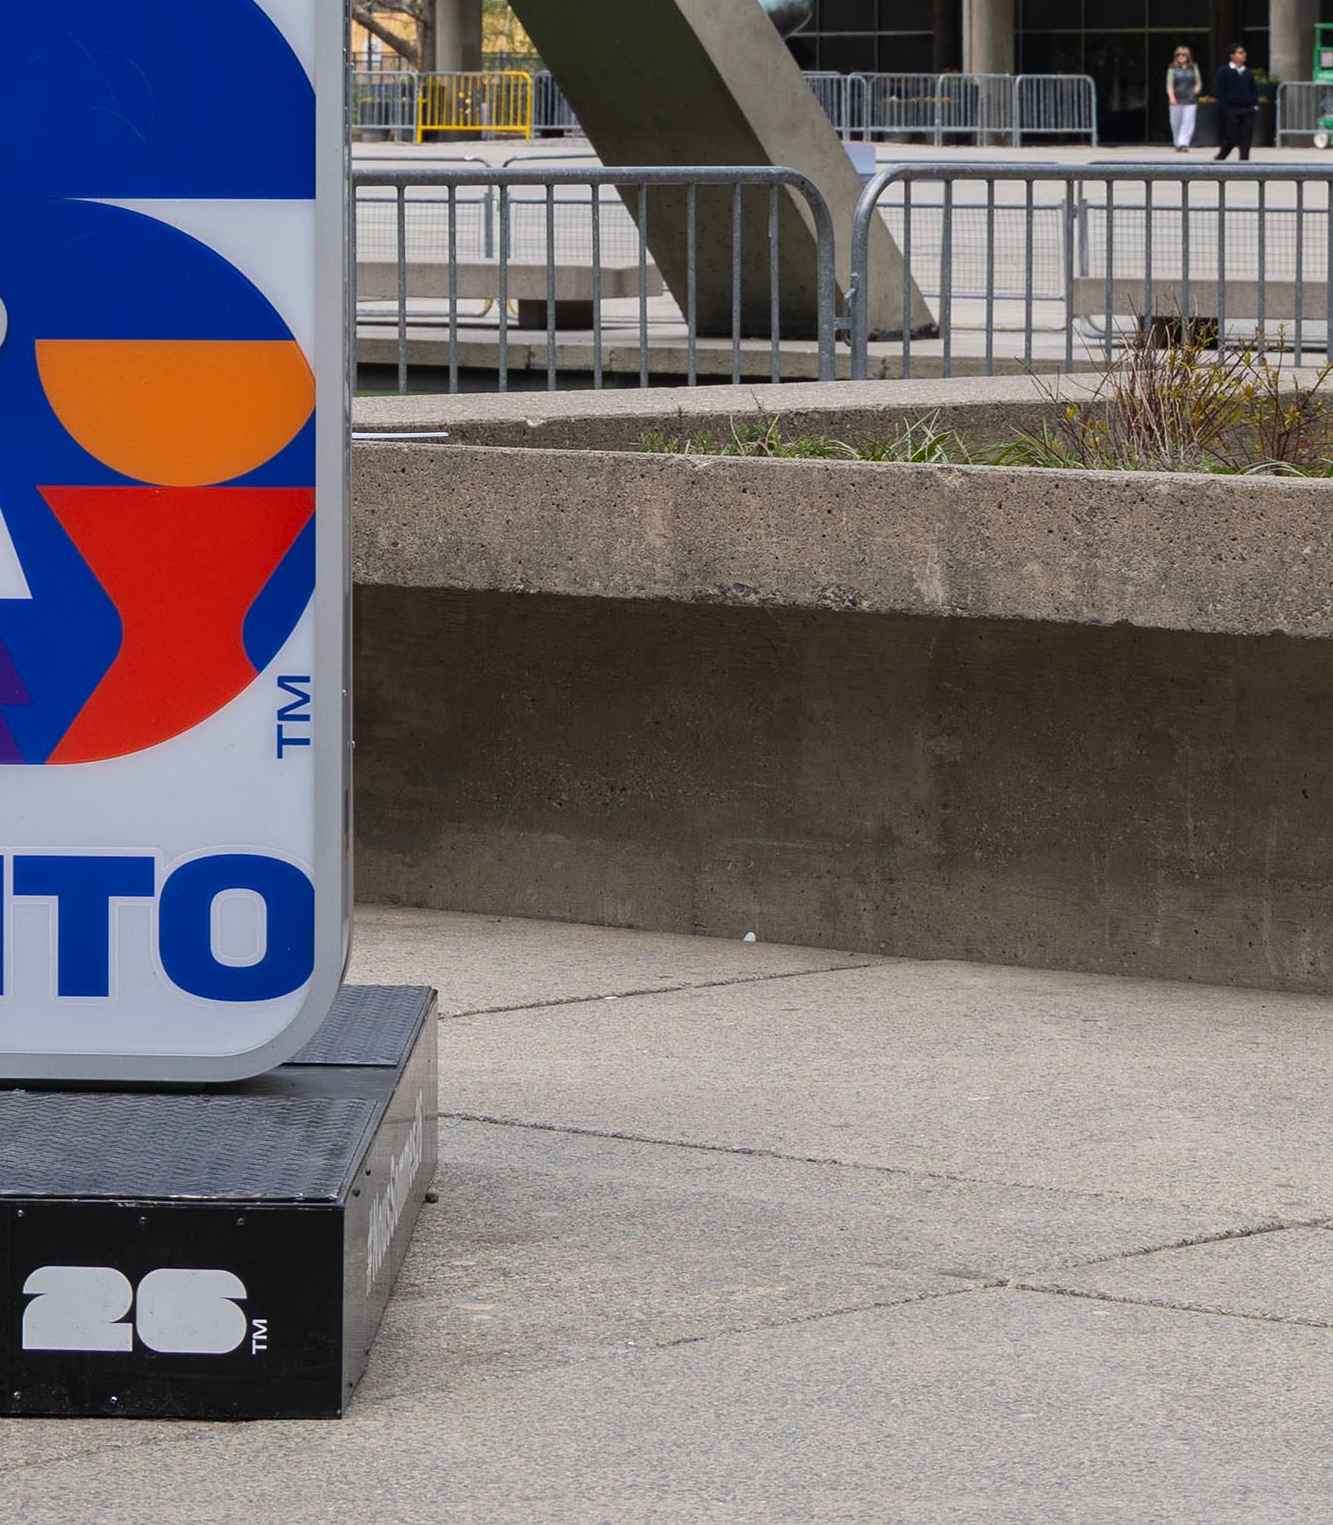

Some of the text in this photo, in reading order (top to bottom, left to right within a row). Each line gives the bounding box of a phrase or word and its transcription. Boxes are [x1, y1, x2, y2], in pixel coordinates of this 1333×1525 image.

[276, 675, 311, 759] TM
[21, 1265, 248, 1354] 26
[251, 1319, 268, 1354] TM
